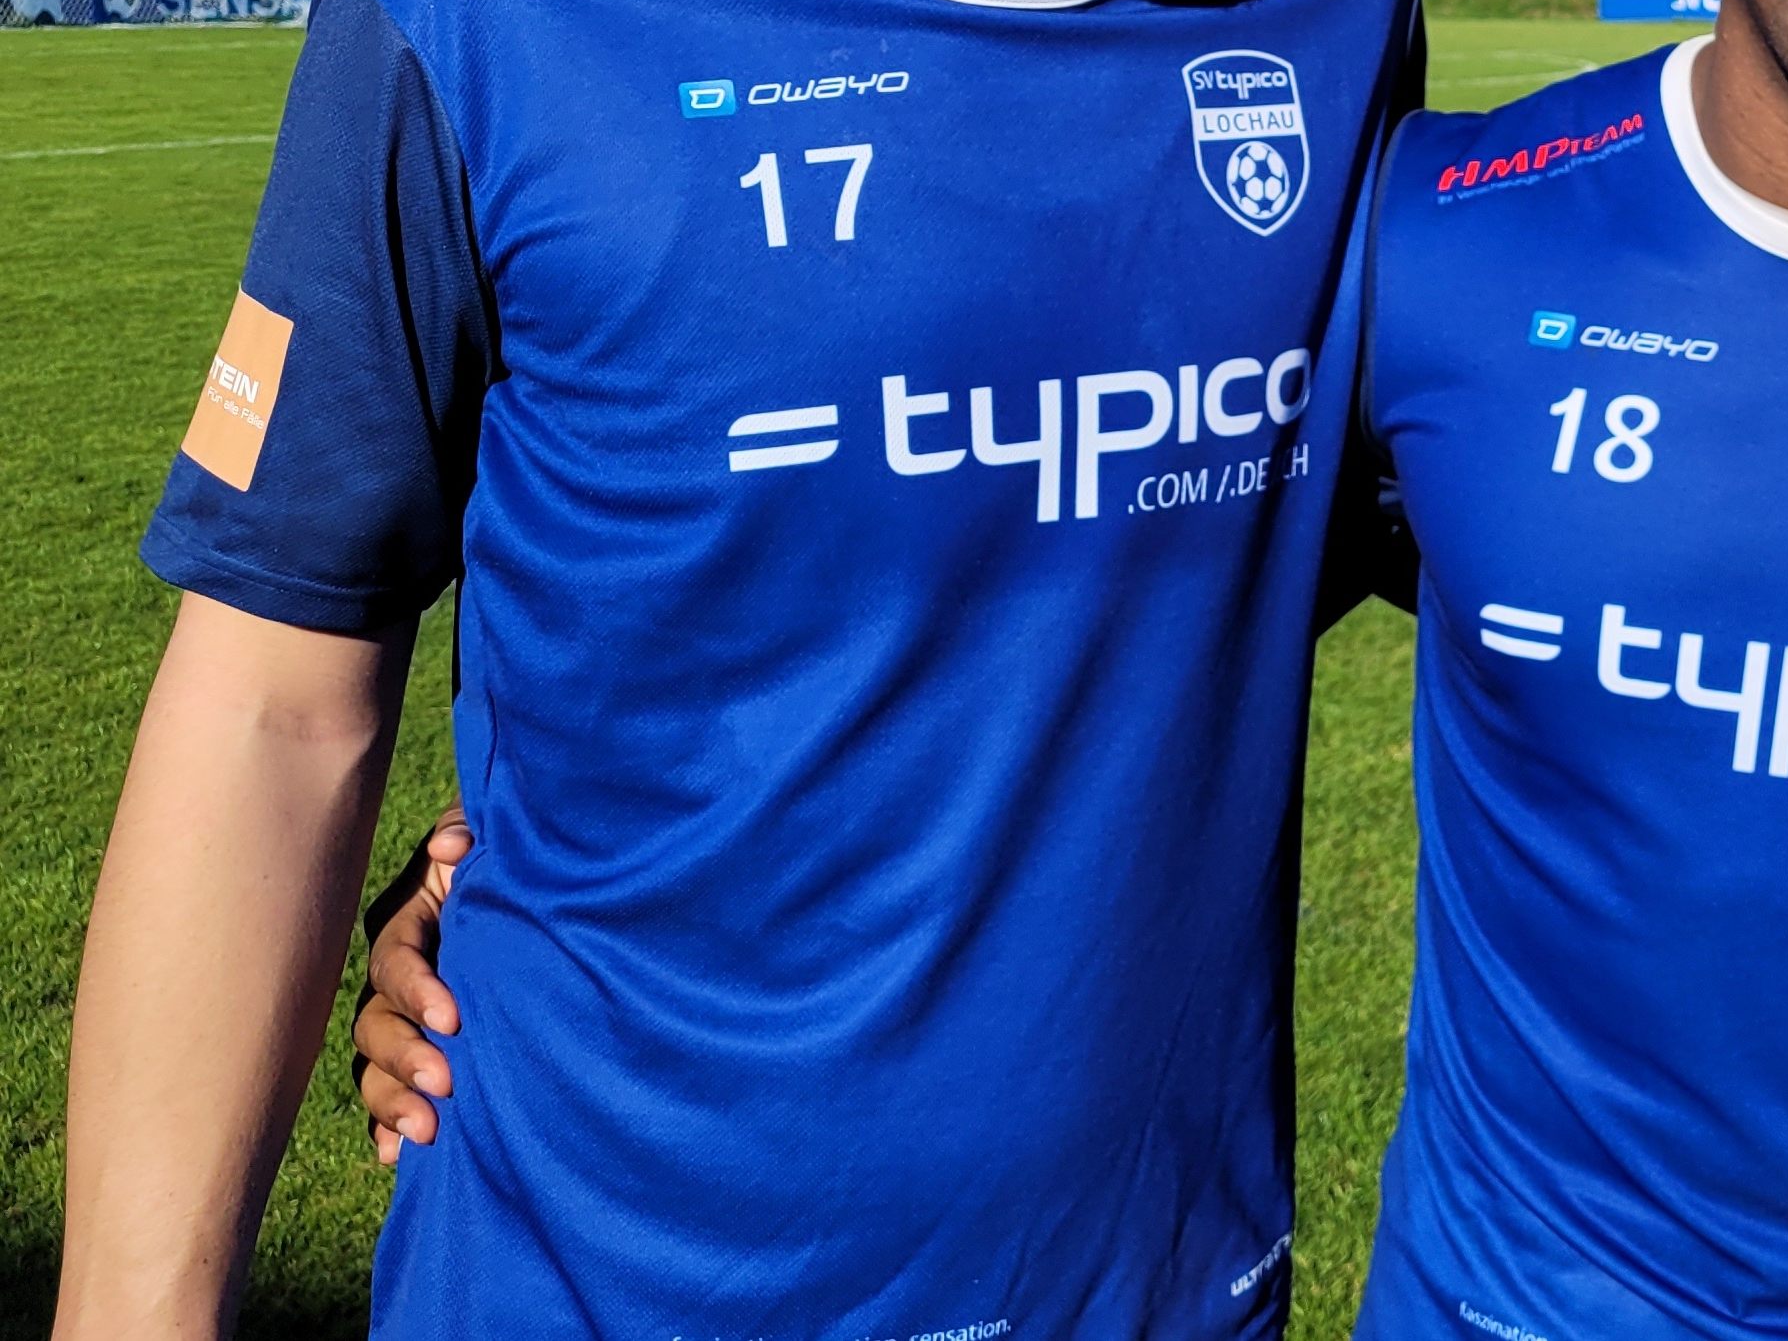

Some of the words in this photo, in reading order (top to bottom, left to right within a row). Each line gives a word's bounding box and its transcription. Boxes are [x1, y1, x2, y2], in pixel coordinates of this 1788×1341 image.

[1202, 110, 1296, 134] LOCHAU
[739, 143, 874, 248] 17
[209, 355, 260, 404] TEIN
[882, 348, 1311, 524] typico
[1549, 387, 1661, 483] 18
